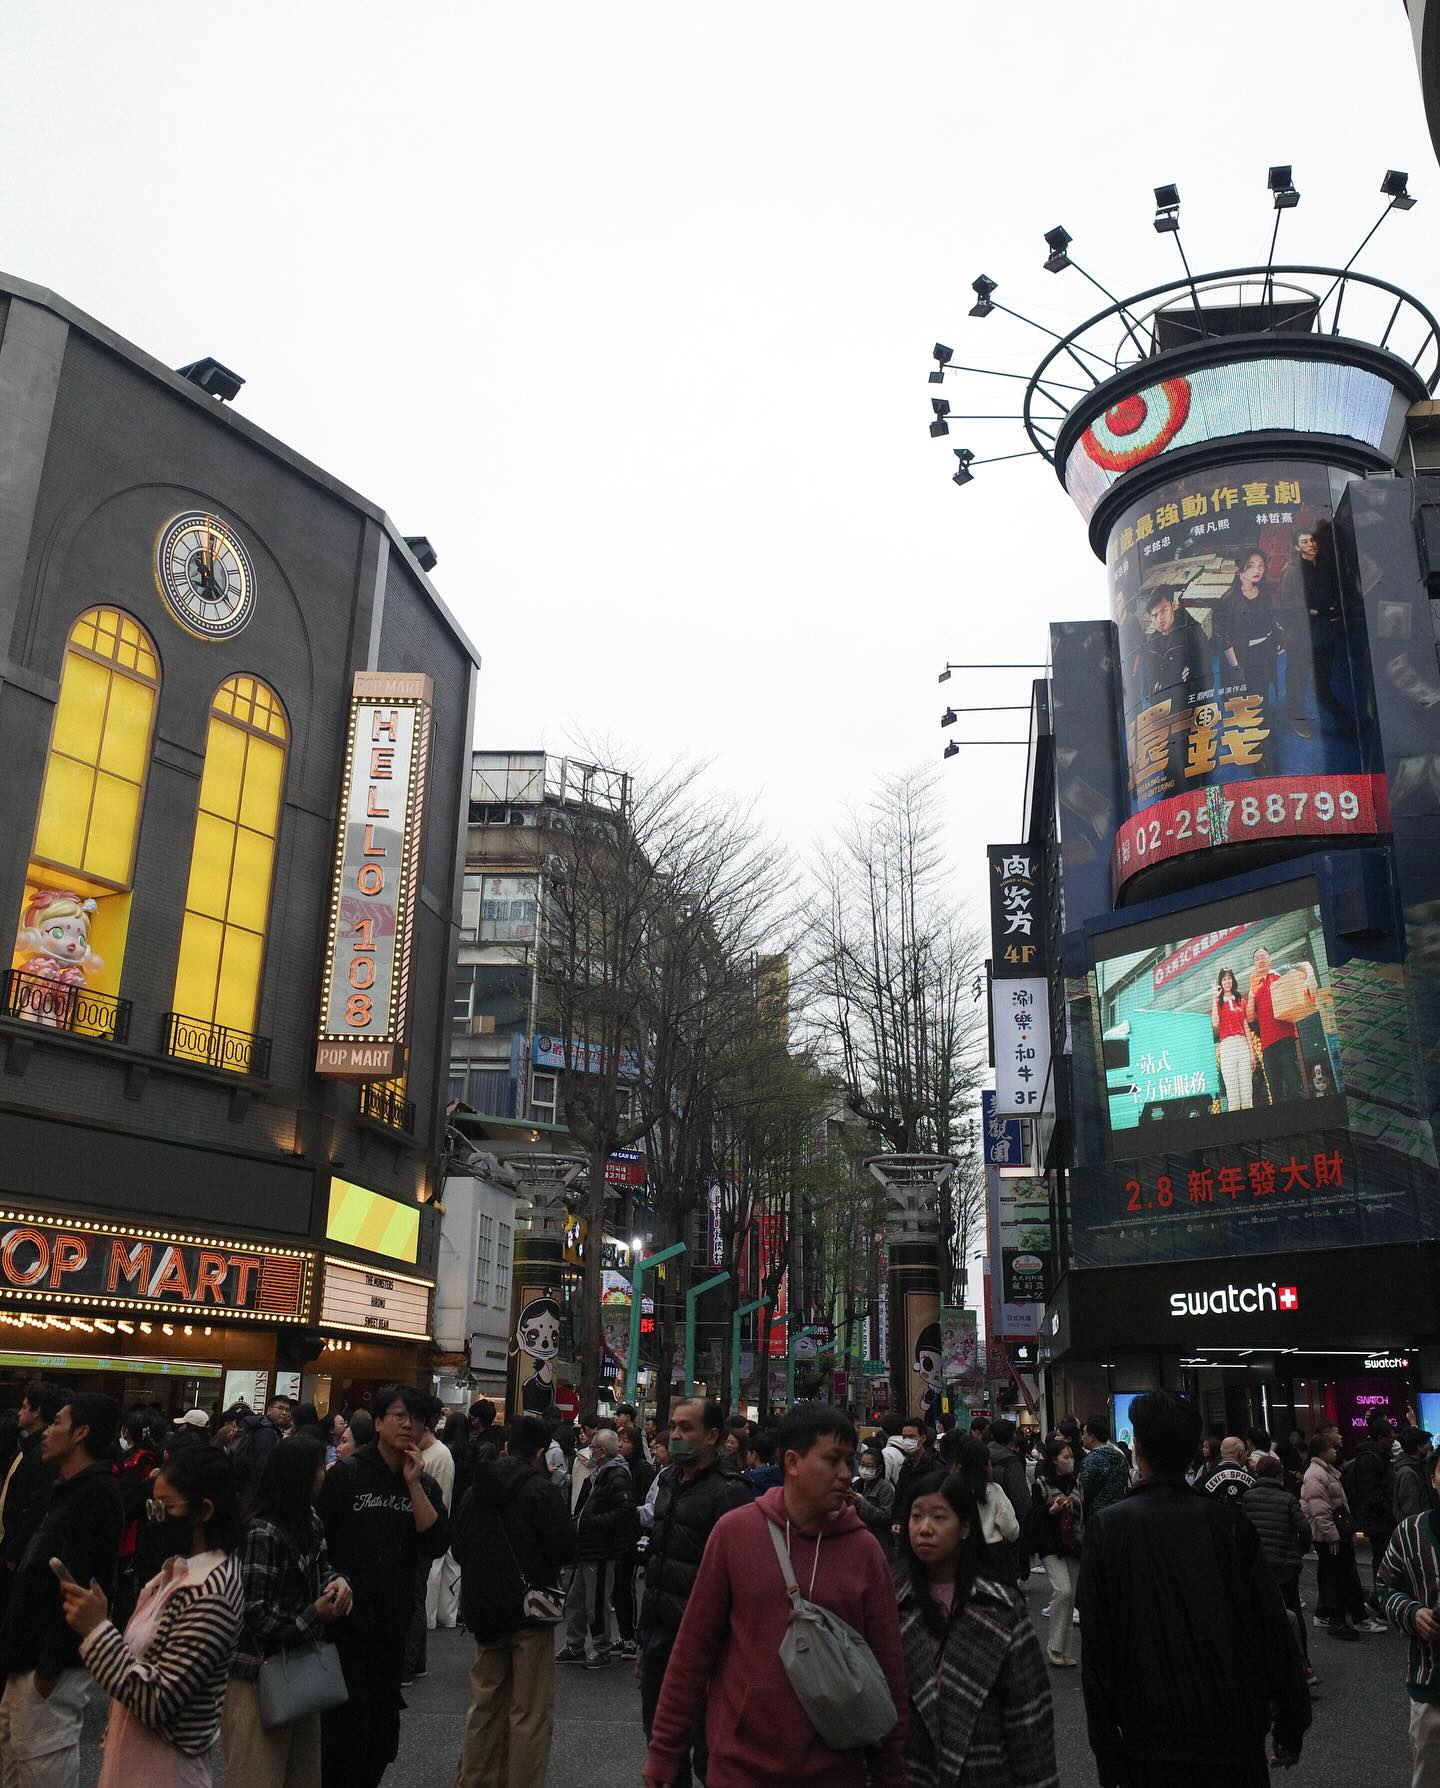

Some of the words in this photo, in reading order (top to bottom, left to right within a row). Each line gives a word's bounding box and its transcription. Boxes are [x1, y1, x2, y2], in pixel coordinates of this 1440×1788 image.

[357, 709, 398, 897] HELLO
[1003, 944, 1038, 964] 4F
[344, 918, 377, 1028] 108
[319, 1050, 348, 1067] POP
[350, 1051, 391, 1068] MART
[1015, 1091, 1038, 1105] 3F
[1124, 1175, 1174, 1212] 2.8
[1186, 1150, 1345, 1204] 新年發大財
[106, 1238, 259, 1309] MART
[1170, 1282, 1277, 1316] swatch
[1364, 1357, 1402, 1369] swatch
[1356, 1395, 1389, 1405] SWATCH
[1206, 1471, 1226, 1491] LEVI'S
[1230, 1471, 1256, 1488] SPORT
